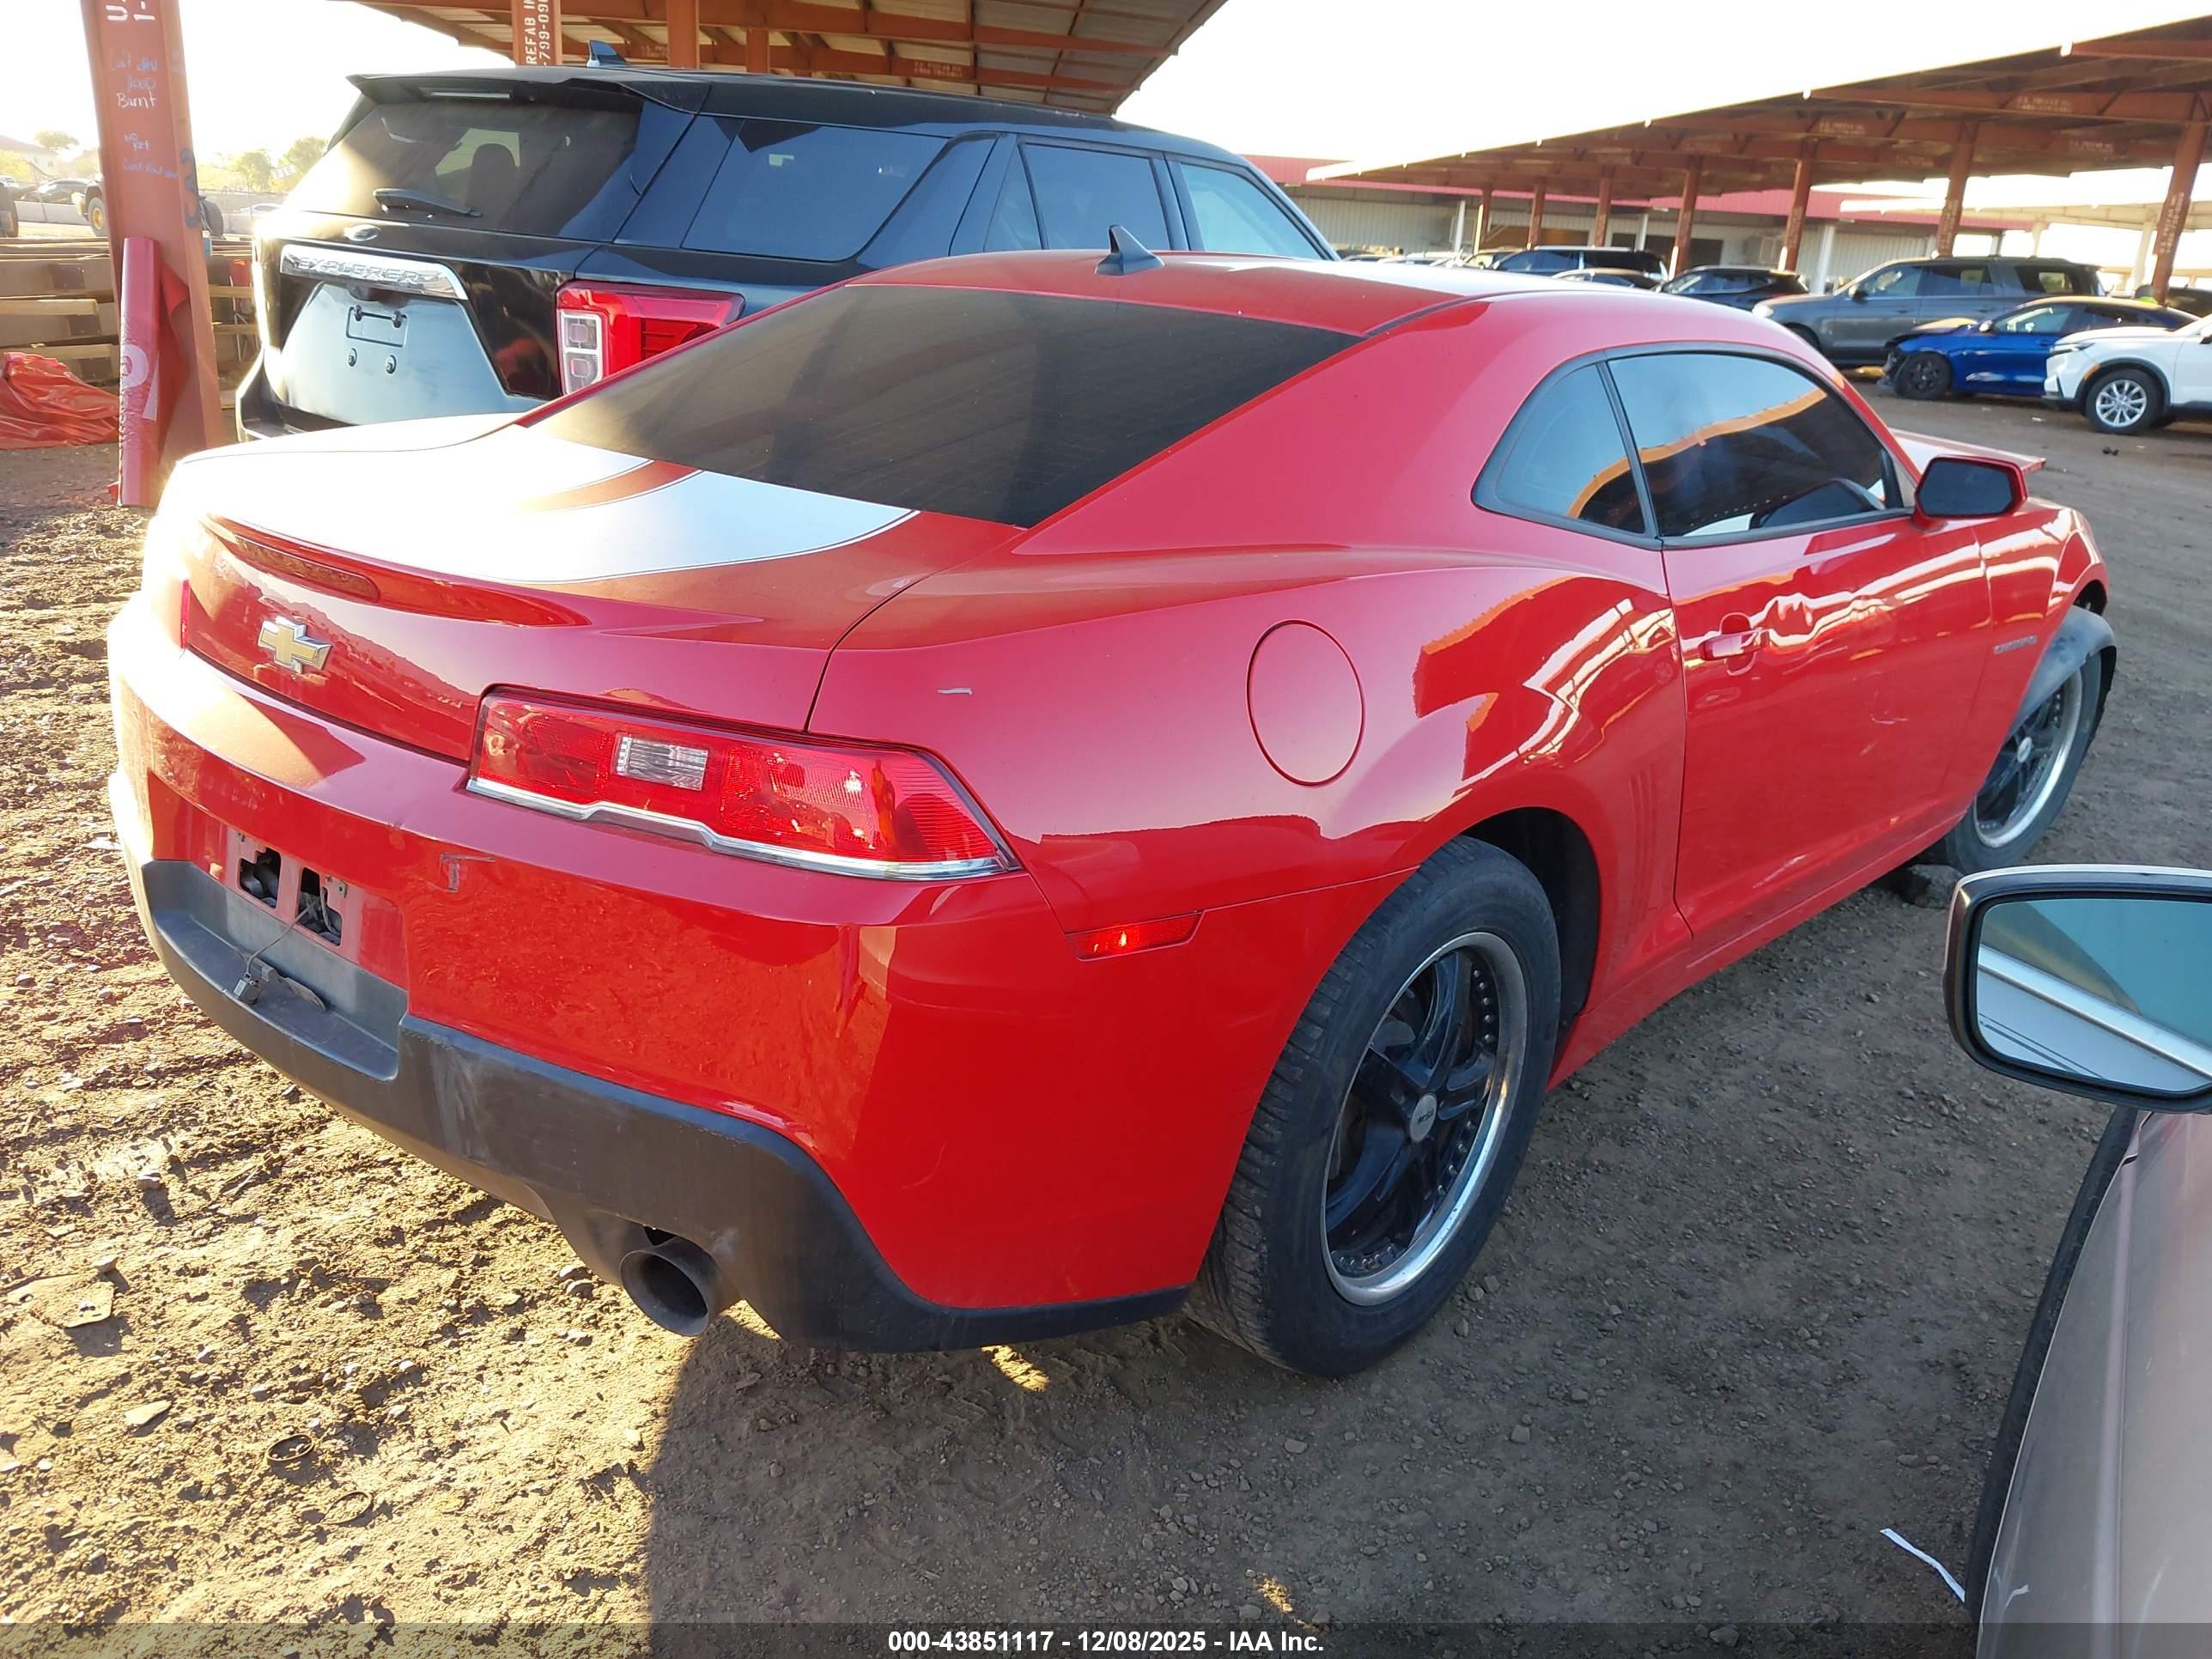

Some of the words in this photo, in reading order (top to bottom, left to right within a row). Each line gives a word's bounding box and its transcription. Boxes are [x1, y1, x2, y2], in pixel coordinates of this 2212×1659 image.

[524, 17, 538, 64] REFAB
[117, 91, 157, 108] Burnt
[298, 258, 421, 285] EXPLORER
